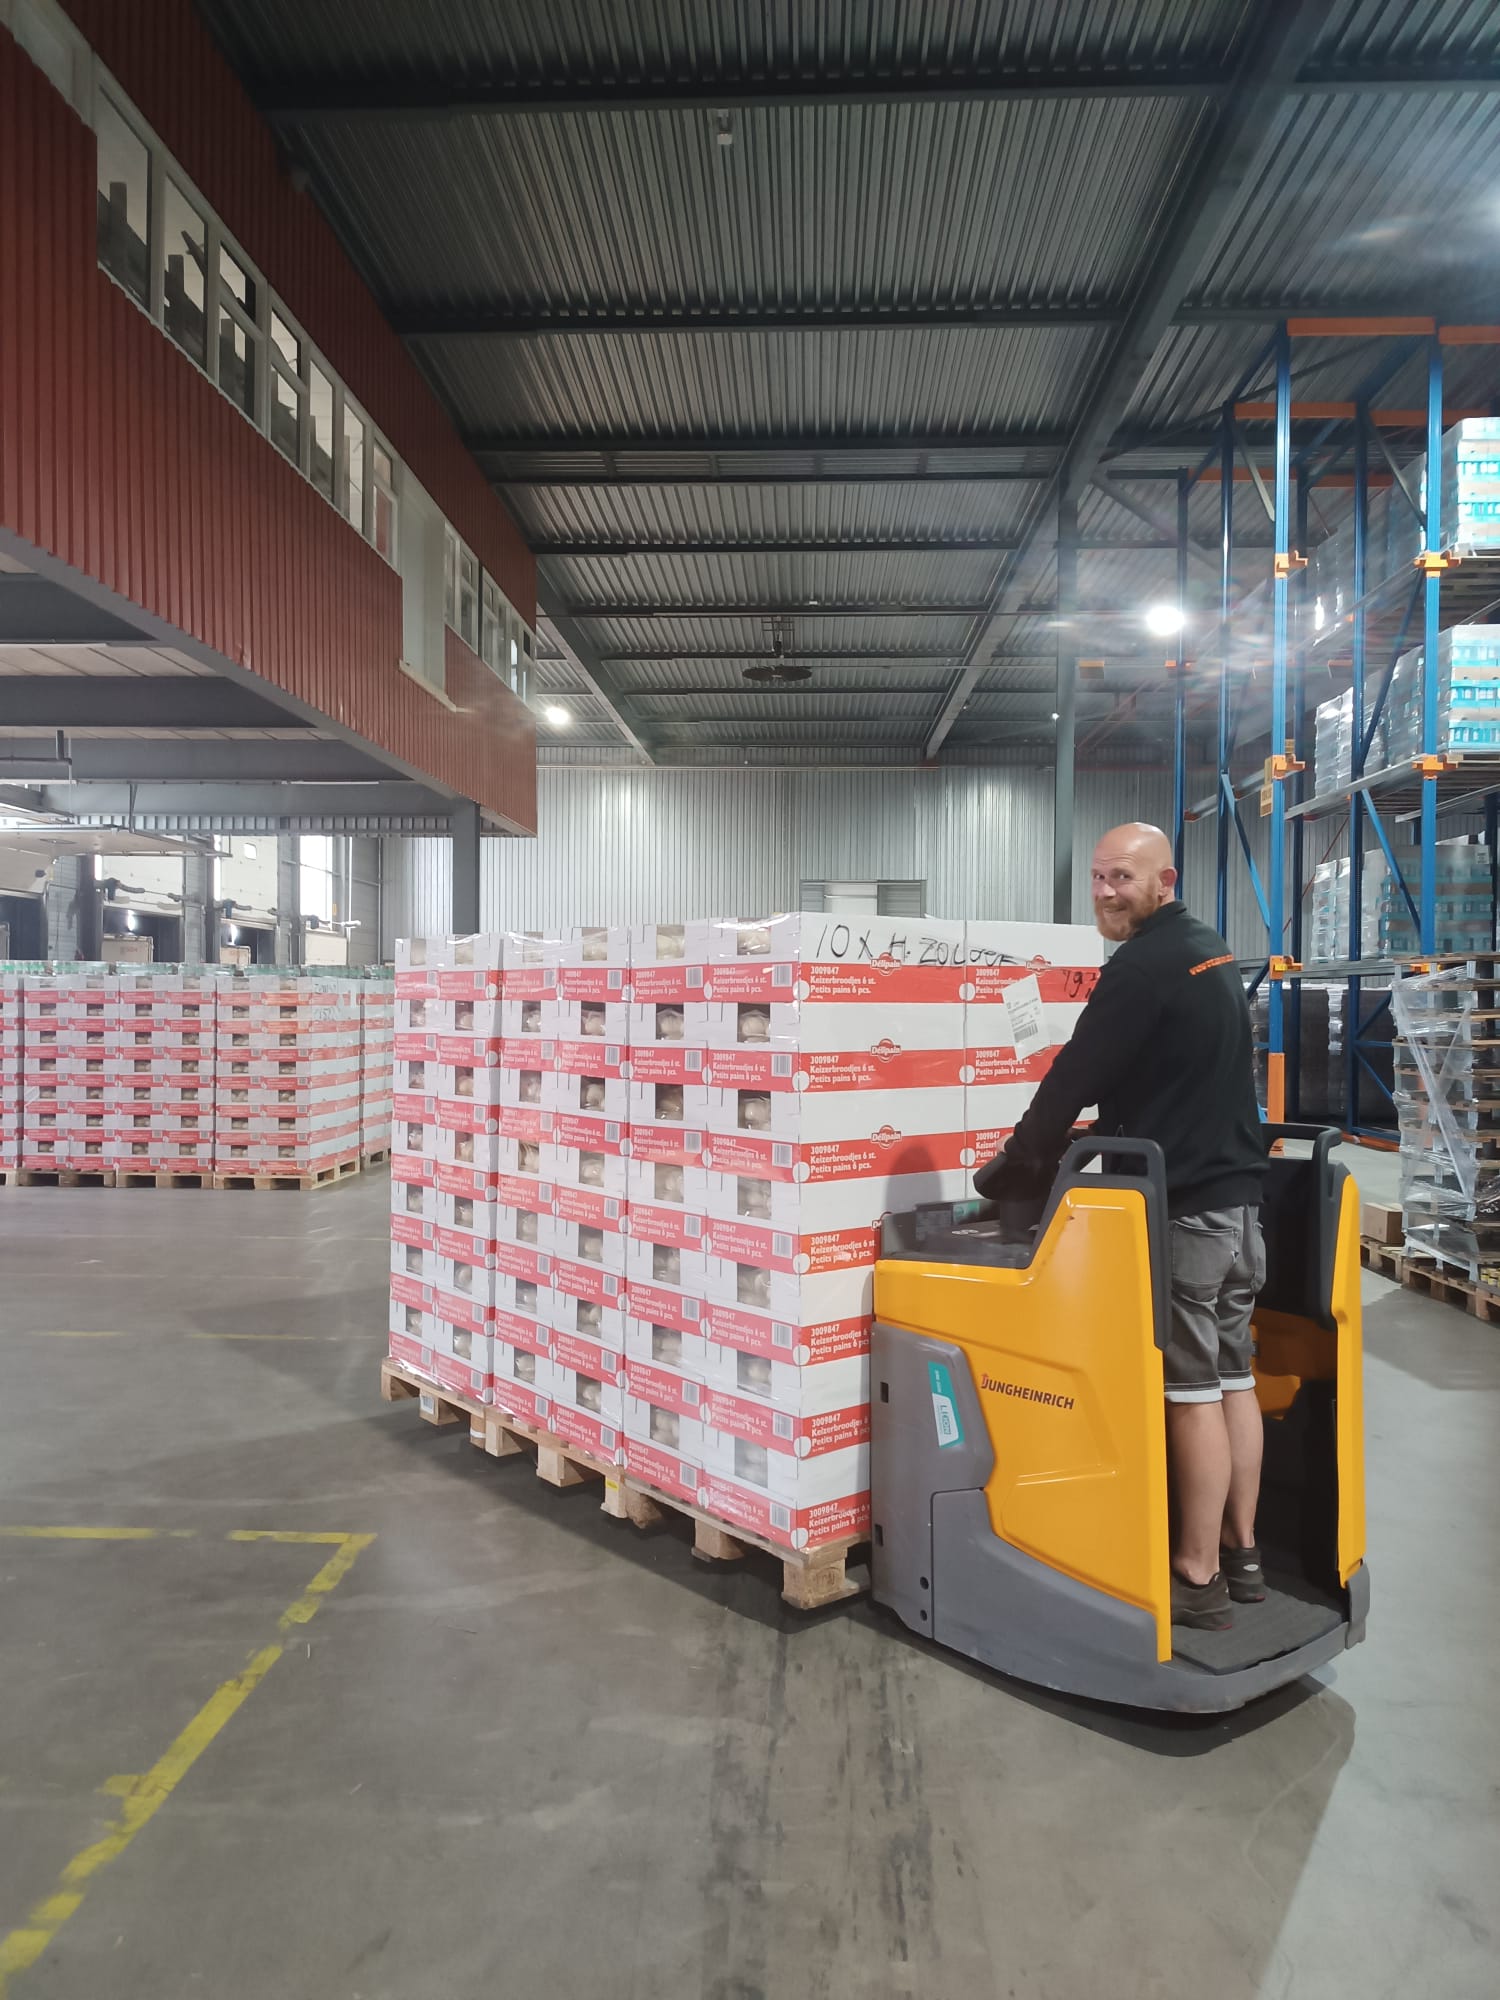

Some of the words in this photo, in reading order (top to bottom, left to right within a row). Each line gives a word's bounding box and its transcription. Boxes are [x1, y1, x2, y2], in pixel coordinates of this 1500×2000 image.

[811, 966, 839, 974] 3009847
[811, 976, 860, 986] Keizerbroodjes
[832, 986, 850, 995] pains
[810, 1055, 838, 1064] 3009847
[810, 1064, 860, 1076] Keizerbroodjes
[810, 1074, 830, 1082] Petits
[832, 1074, 850, 1083] pains
[811, 1143, 839, 1154] 3009847
[811, 1152, 860, 1166] Keizerbroodjes
[811, 1163, 831, 1172] Petits
[832, 1163, 850, 1173] pains
[811, 1233, 839, 1246] 3009847
[811, 1240, 860, 1257] Keizerbroodjes
[811, 1254, 831, 1264] Petits
[811, 1322, 839, 1337] 3009847
[811, 1328, 860, 1349] Keizerbroodjes
[811, 1344, 831, 1356] Petits
[832, 1341, 850, 1354] pains
[981, 1375, 1075, 1410] JUNGHEINRICH
[812, 1412, 840, 1428] 3009847
[812, 1417, 862, 1440] Keizerbroodjes
[812, 1434, 832, 1447] Petits
[834, 1430, 852, 1443] pains
[809, 1501, 837, 1519] 3009847
[809, 1504, 859, 1530] Keizerbroodjes
[809, 1523, 829, 1538] Petits
[830, 1518, 848, 1532] pains
